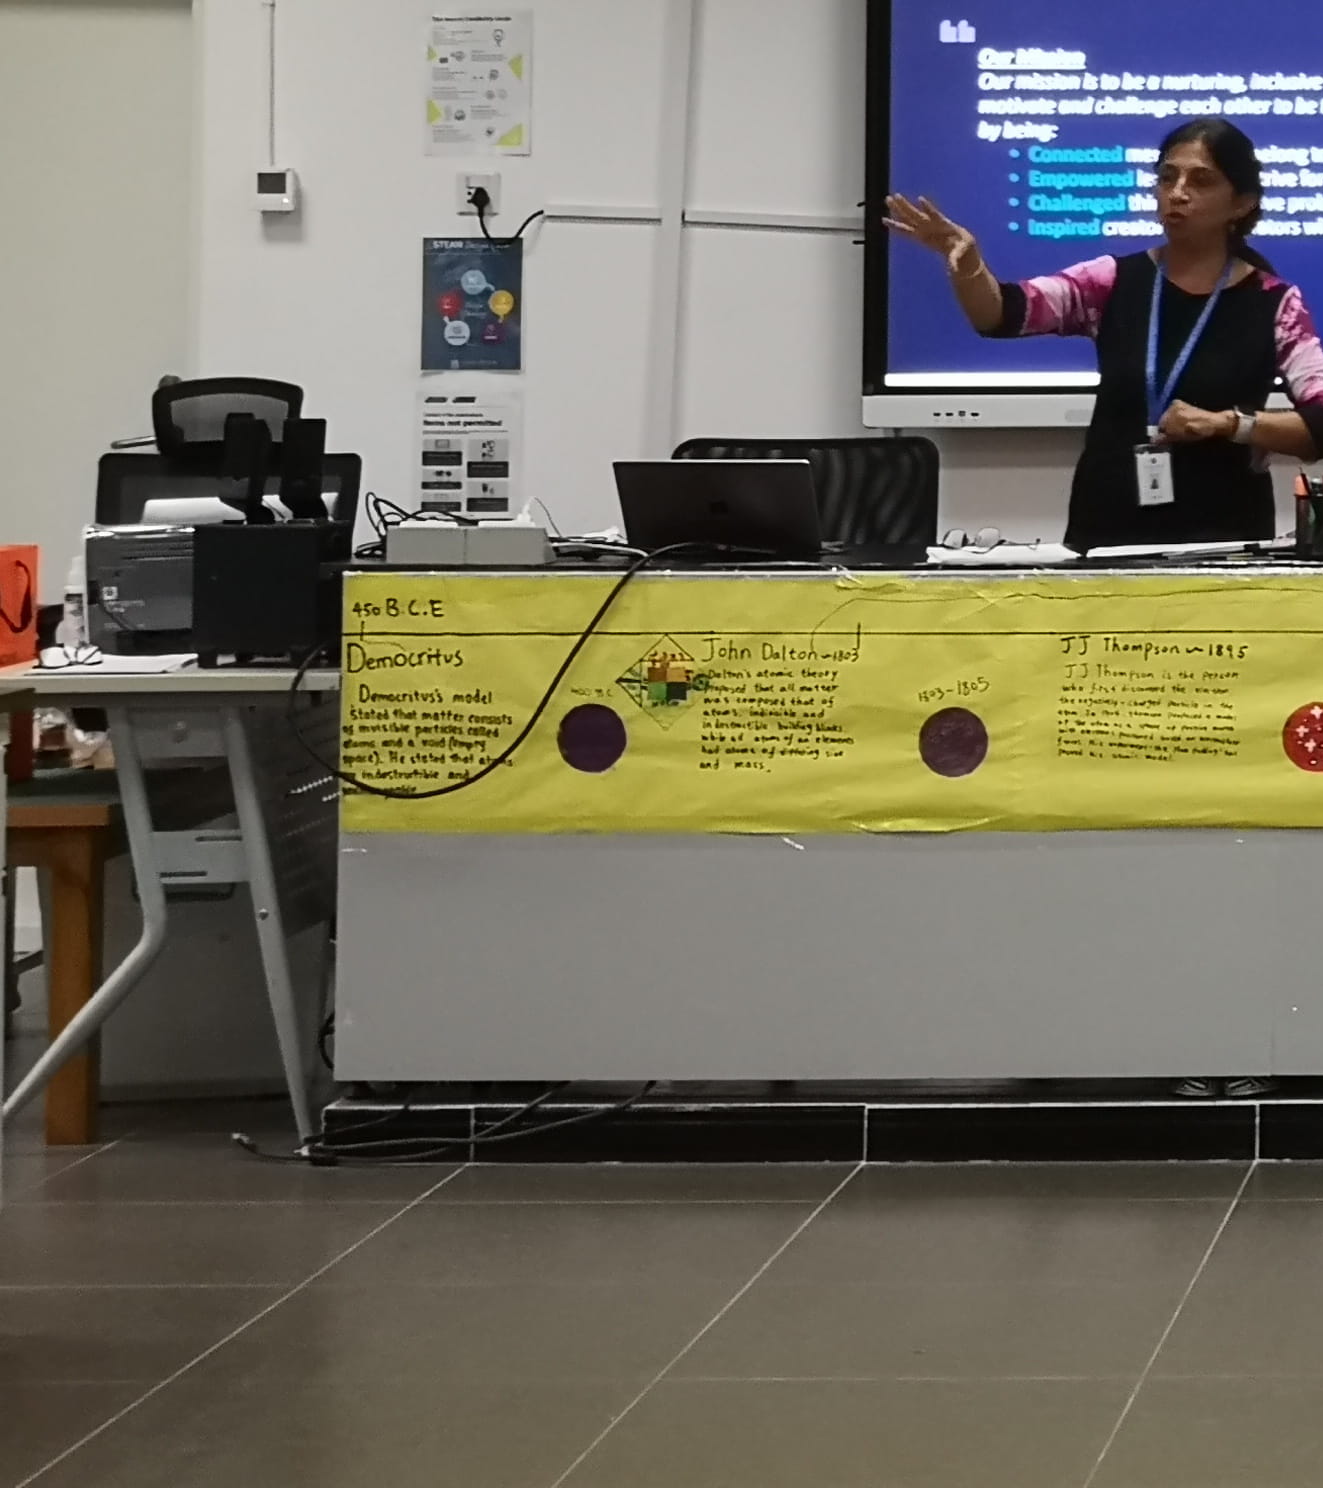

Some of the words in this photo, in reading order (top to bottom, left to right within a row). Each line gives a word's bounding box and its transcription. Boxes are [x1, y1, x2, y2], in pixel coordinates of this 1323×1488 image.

[977, 47, 1014, 68] Our
[1015, 47, 1086, 69] Mission
[978, 73, 1014, 91] Our
[1015, 73, 1081, 91] mission
[1083, 73, 1099, 91] is
[1100, 73, 1121, 91] to
[1121, 73, 1146, 91] be
[1146, 76, 1161, 91] a
[1162, 73, 1247, 94] nurturing,
[1249, 73, 1323, 91] inclusive
[977, 96, 1057, 115] motivate
[1057, 96, 1094, 115] and
[1095, 96, 1179, 118] challenge
[1179, 96, 1222, 115] each
[1223, 96, 1272, 115] other
[1272, 96, 1294, 115] to
[1294, 96, 1318, 115] be
[977, 121, 1002, 142] by
[1002, 121, 1059, 142] being:
[1027, 145, 1124, 164] Connected
[1028, 169, 1134, 191] Empowered
[1259, 169, 1299, 188] rive
[1027, 194, 1126, 215] Challenged
[1027, 218, 1101, 238] Inspired
[1102, 218, 1164, 236] creator
[352, 601, 381, 618] 450
[346, 642, 464, 674] Democritus
[701, 637, 752, 663] John
[761, 641, 818, 662] Dalton
[1060, 635, 1091, 655] JJ
[1103, 636, 1181, 662] Thompson
[801, 668, 838, 682] theory
[1064, 663, 1089, 679] JJ
[1096, 663, 1155, 682] Thompson
[452, 688, 493, 705] model
[754, 683, 775, 693] that
[392, 707, 418, 720] that
[421, 709, 465, 722] matter
[414, 724, 464, 738] particles
[381, 737, 403, 748] and
[388, 750, 405, 764] He
[449, 753, 475, 764] that
